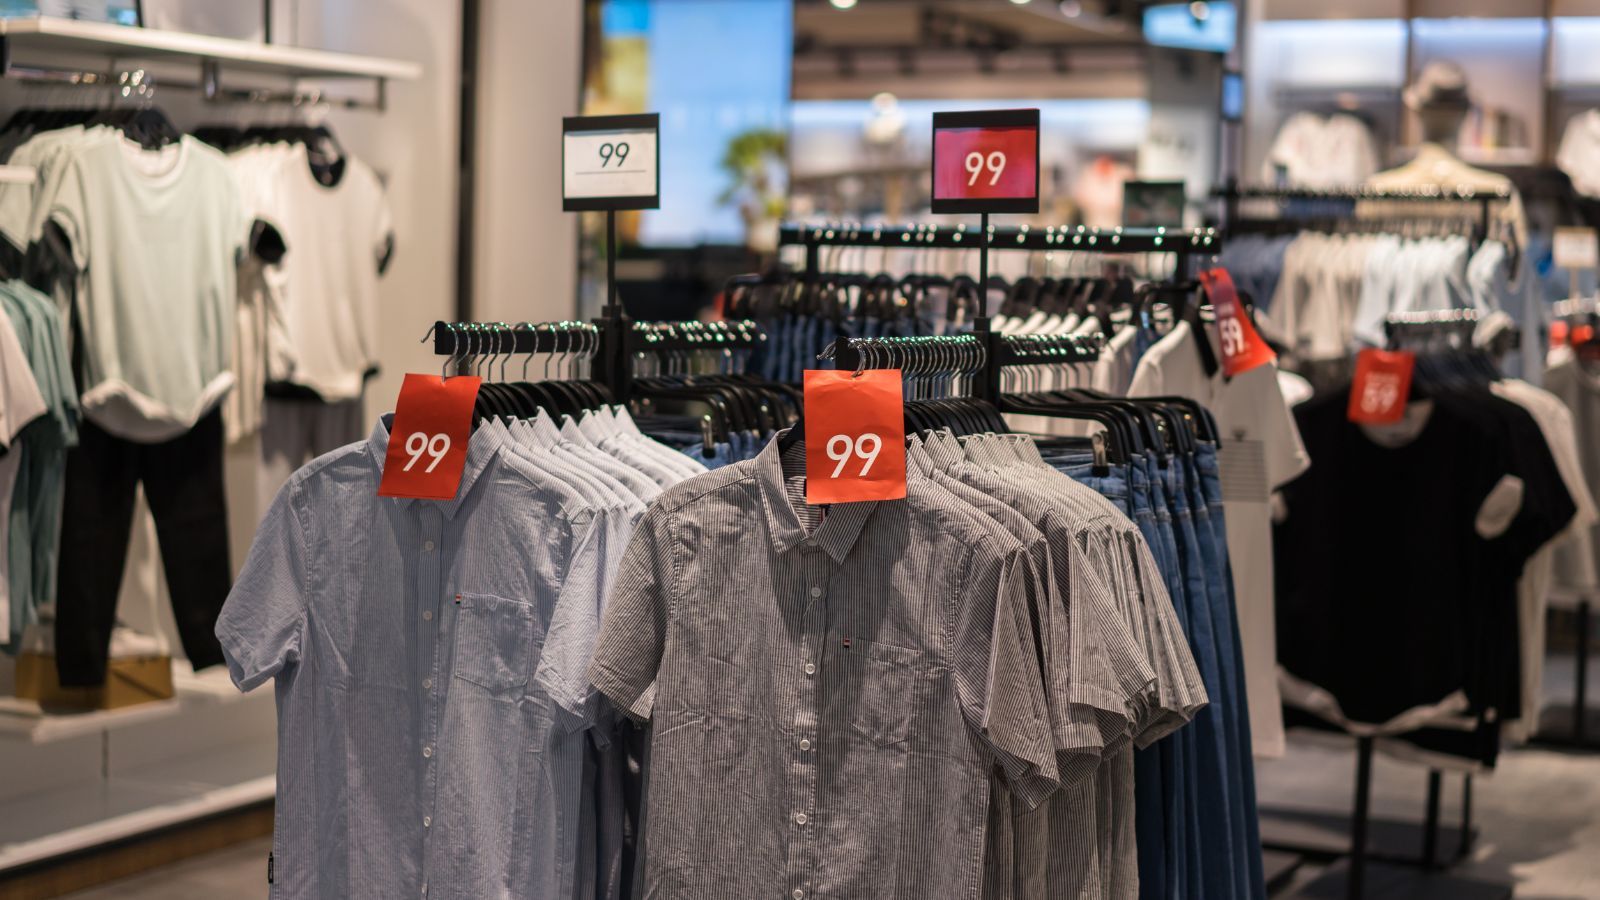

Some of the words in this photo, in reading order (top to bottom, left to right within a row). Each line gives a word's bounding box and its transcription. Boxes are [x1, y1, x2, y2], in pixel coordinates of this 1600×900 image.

[599, 142, 630, 168] 99
[965, 151, 1006, 186] 99
[1219, 317, 1244, 357] 59
[403, 431, 451, 473] 99
[826, 433, 882, 478] 99
